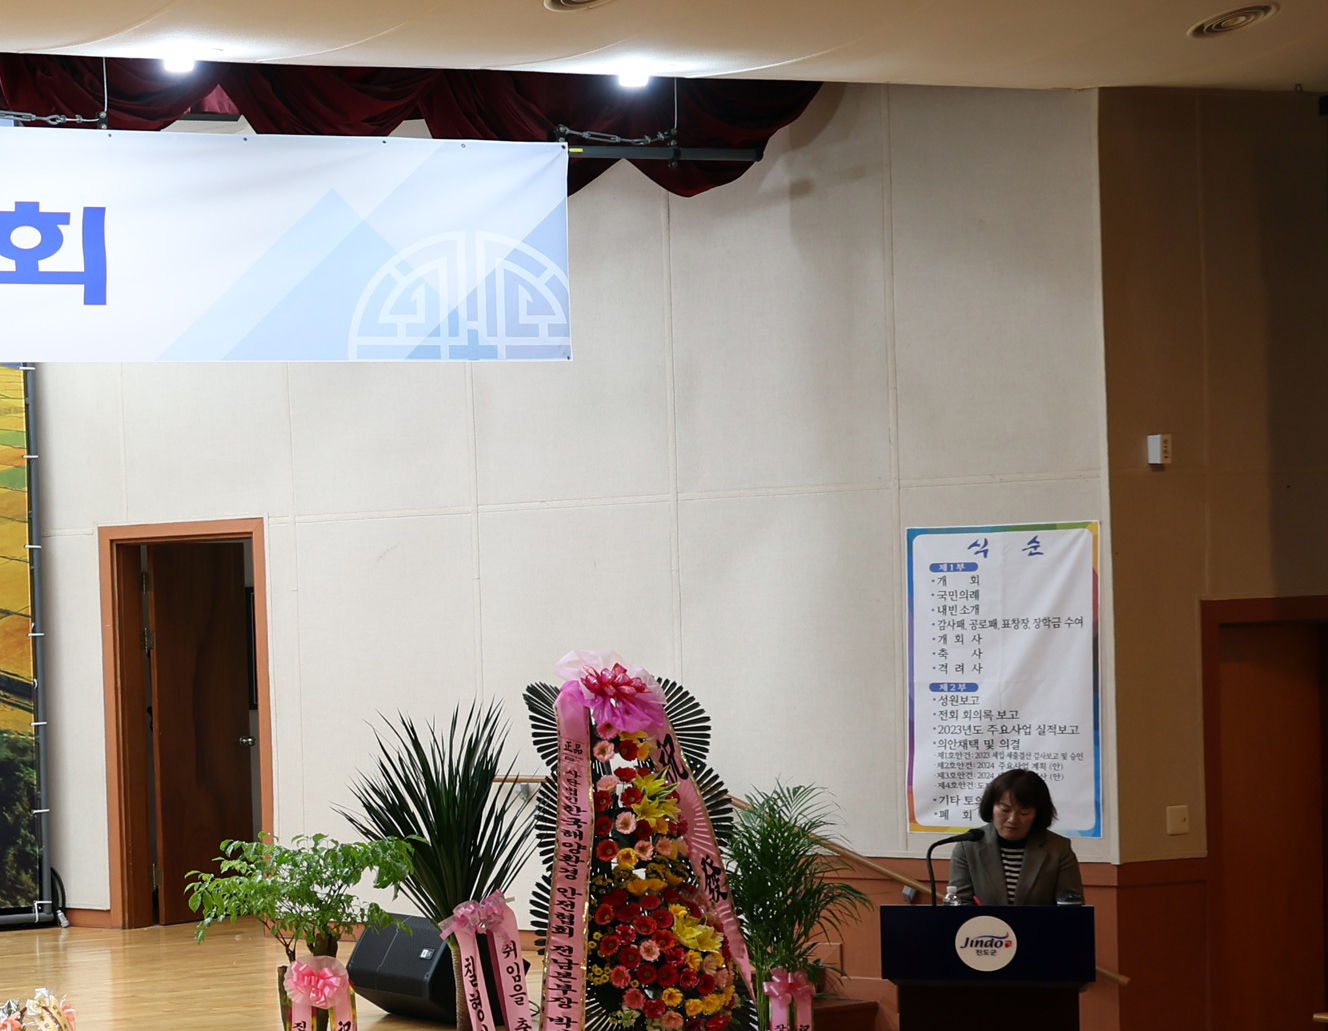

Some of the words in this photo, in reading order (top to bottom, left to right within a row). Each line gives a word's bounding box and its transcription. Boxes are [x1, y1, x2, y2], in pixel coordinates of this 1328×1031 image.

[937, 589, 980, 601] 국민의례
[1032, 617, 1062, 629] 장학금
[1064, 616, 1084, 628] 수여
[938, 695, 980, 706] 성원보고
[937, 709, 959, 721] 전회
[962, 710, 994, 721] 회의록
[996, 710, 1020, 720] 보고
[937, 724, 984, 735] 2023년도
[987, 724, 1032, 735] 주요사업
[1035, 724, 1080, 735] 실적보고
[563, 741, 583, 755] 正品
[937, 739, 979, 750] 의안채택
[983, 739, 995, 750] 및
[999, 739, 1021, 750] 의결
[939, 794, 960, 806] 기타
[551, 887, 583, 938] 안전협회
[960, 937, 1004, 949] Jindo
[976, 949, 997, 957] 진도군
[502, 941, 528, 1006] 취임을
[546, 944, 579, 1010] 전남본부장
